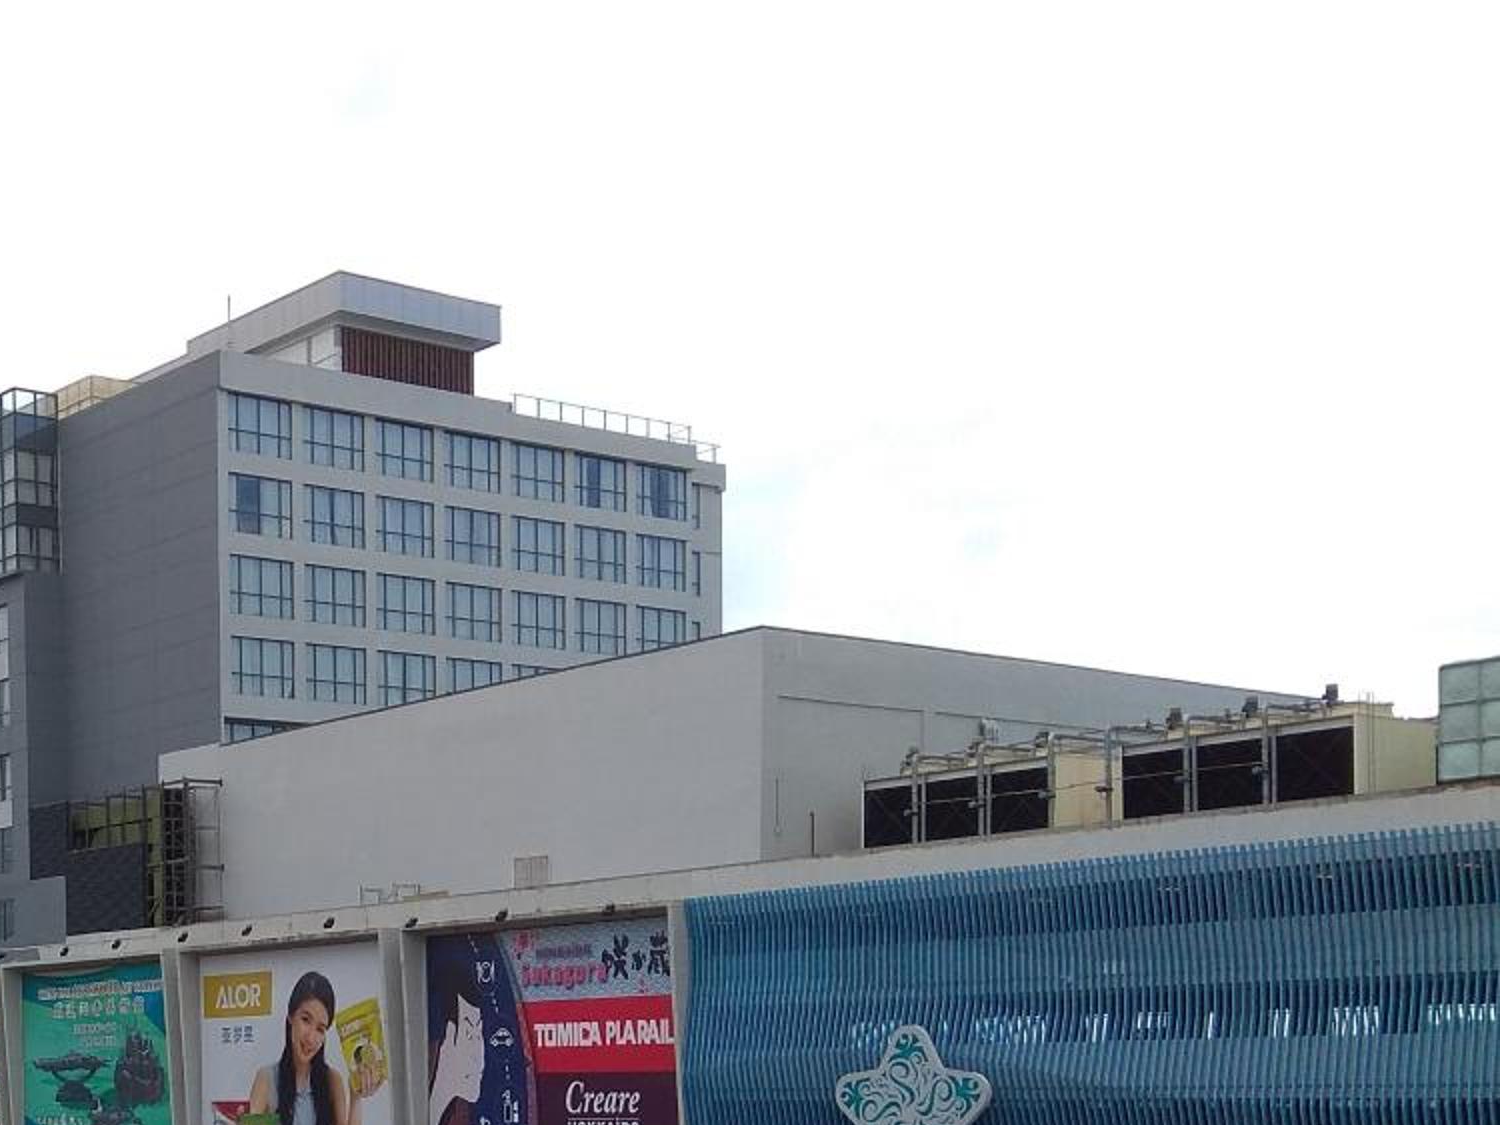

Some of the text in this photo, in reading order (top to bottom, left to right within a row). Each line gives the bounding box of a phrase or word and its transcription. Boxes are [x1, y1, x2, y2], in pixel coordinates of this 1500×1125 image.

[216, 985, 260, 1008] ALOR
[534, 1018, 675, 1047] TOMICA PLARAIL
[565, 1080, 640, 1114] Creare
